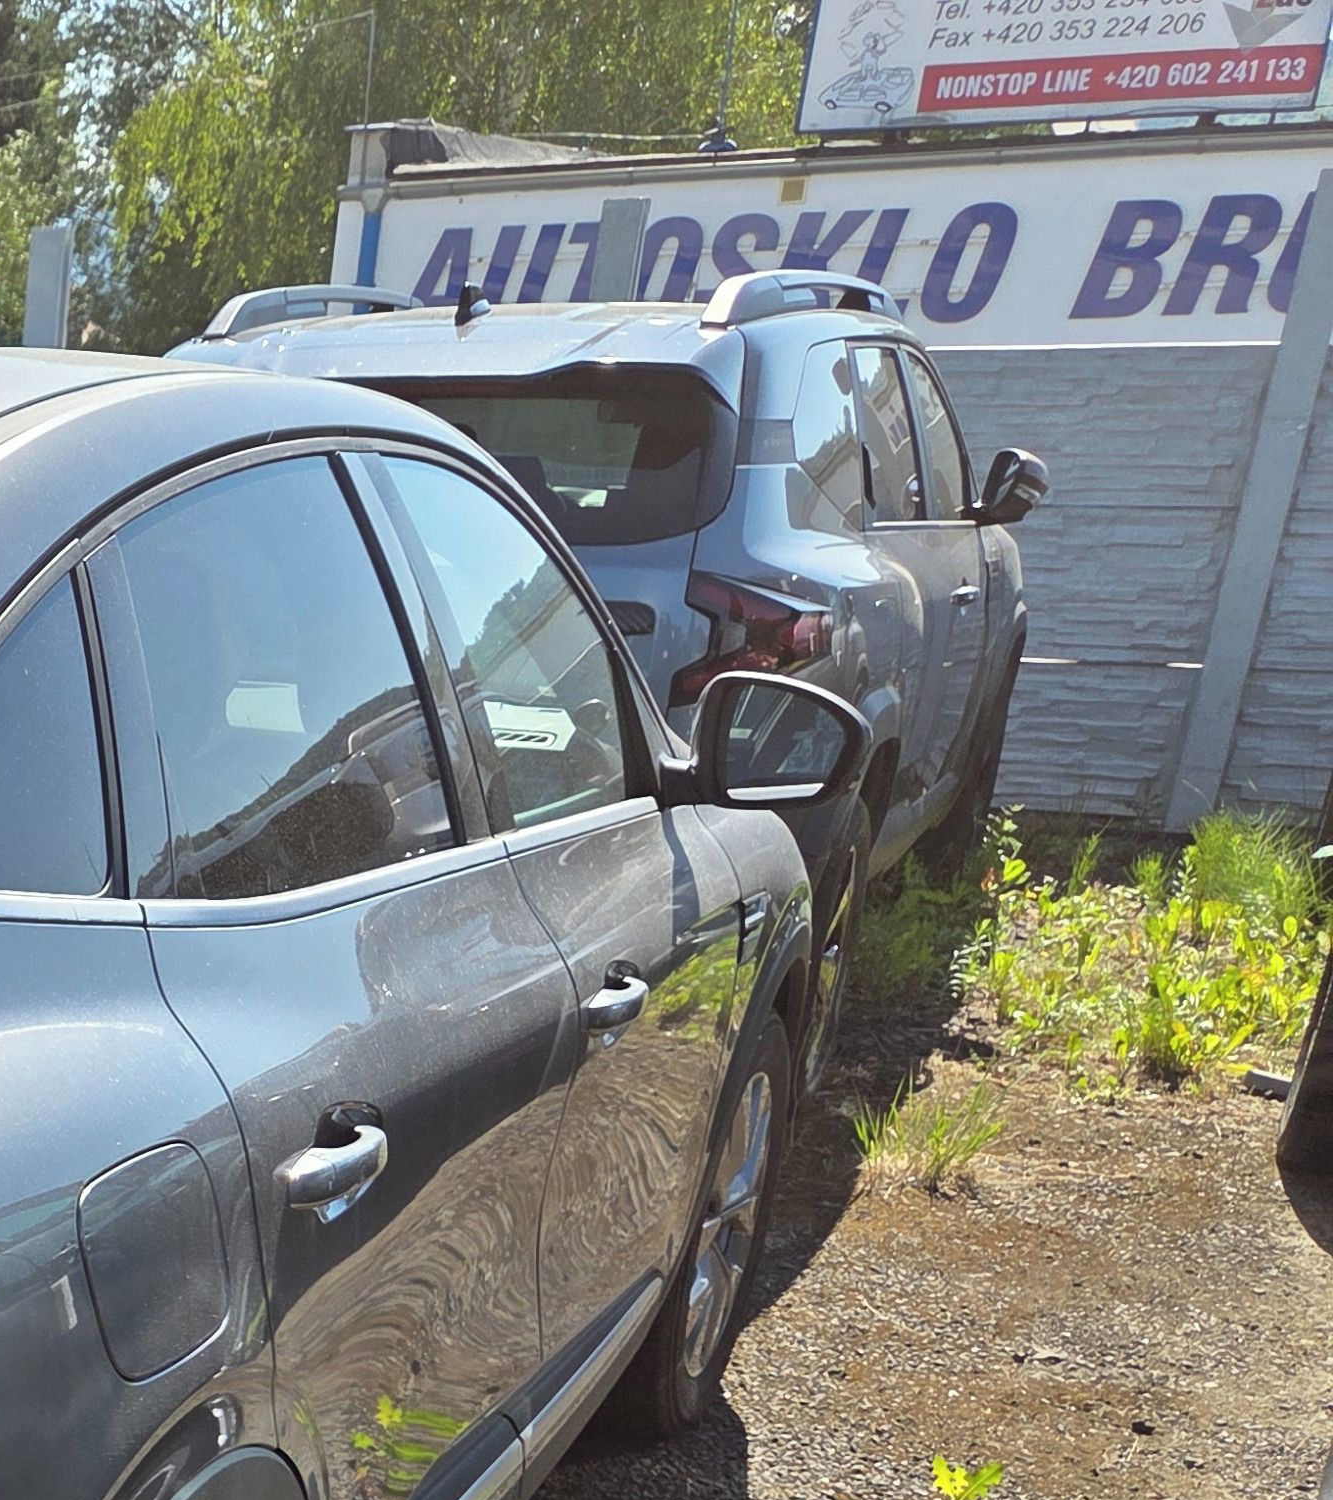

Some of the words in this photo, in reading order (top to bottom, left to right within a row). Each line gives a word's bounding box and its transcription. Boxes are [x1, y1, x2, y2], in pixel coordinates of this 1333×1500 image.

[935, 0, 970, 20] Tel.
[983, 0, 1043, 15] +420
[928, 28, 975, 49] Fax
[983, 22, 1043, 43] +420
[1049, 19, 1096, 41] 353
[1103, 16, 1151, 38] 224
[1157, 12, 1206, 35] 206
[936, 73, 1037, 99] NONSTOP
[1042, 68, 1093, 93] LINE
[1104, 63, 1159, 89] +420
[1166, 61, 1209, 86] 602
[1216, 59, 1259, 84] 241
[1264, 57, 1307, 82] 133
